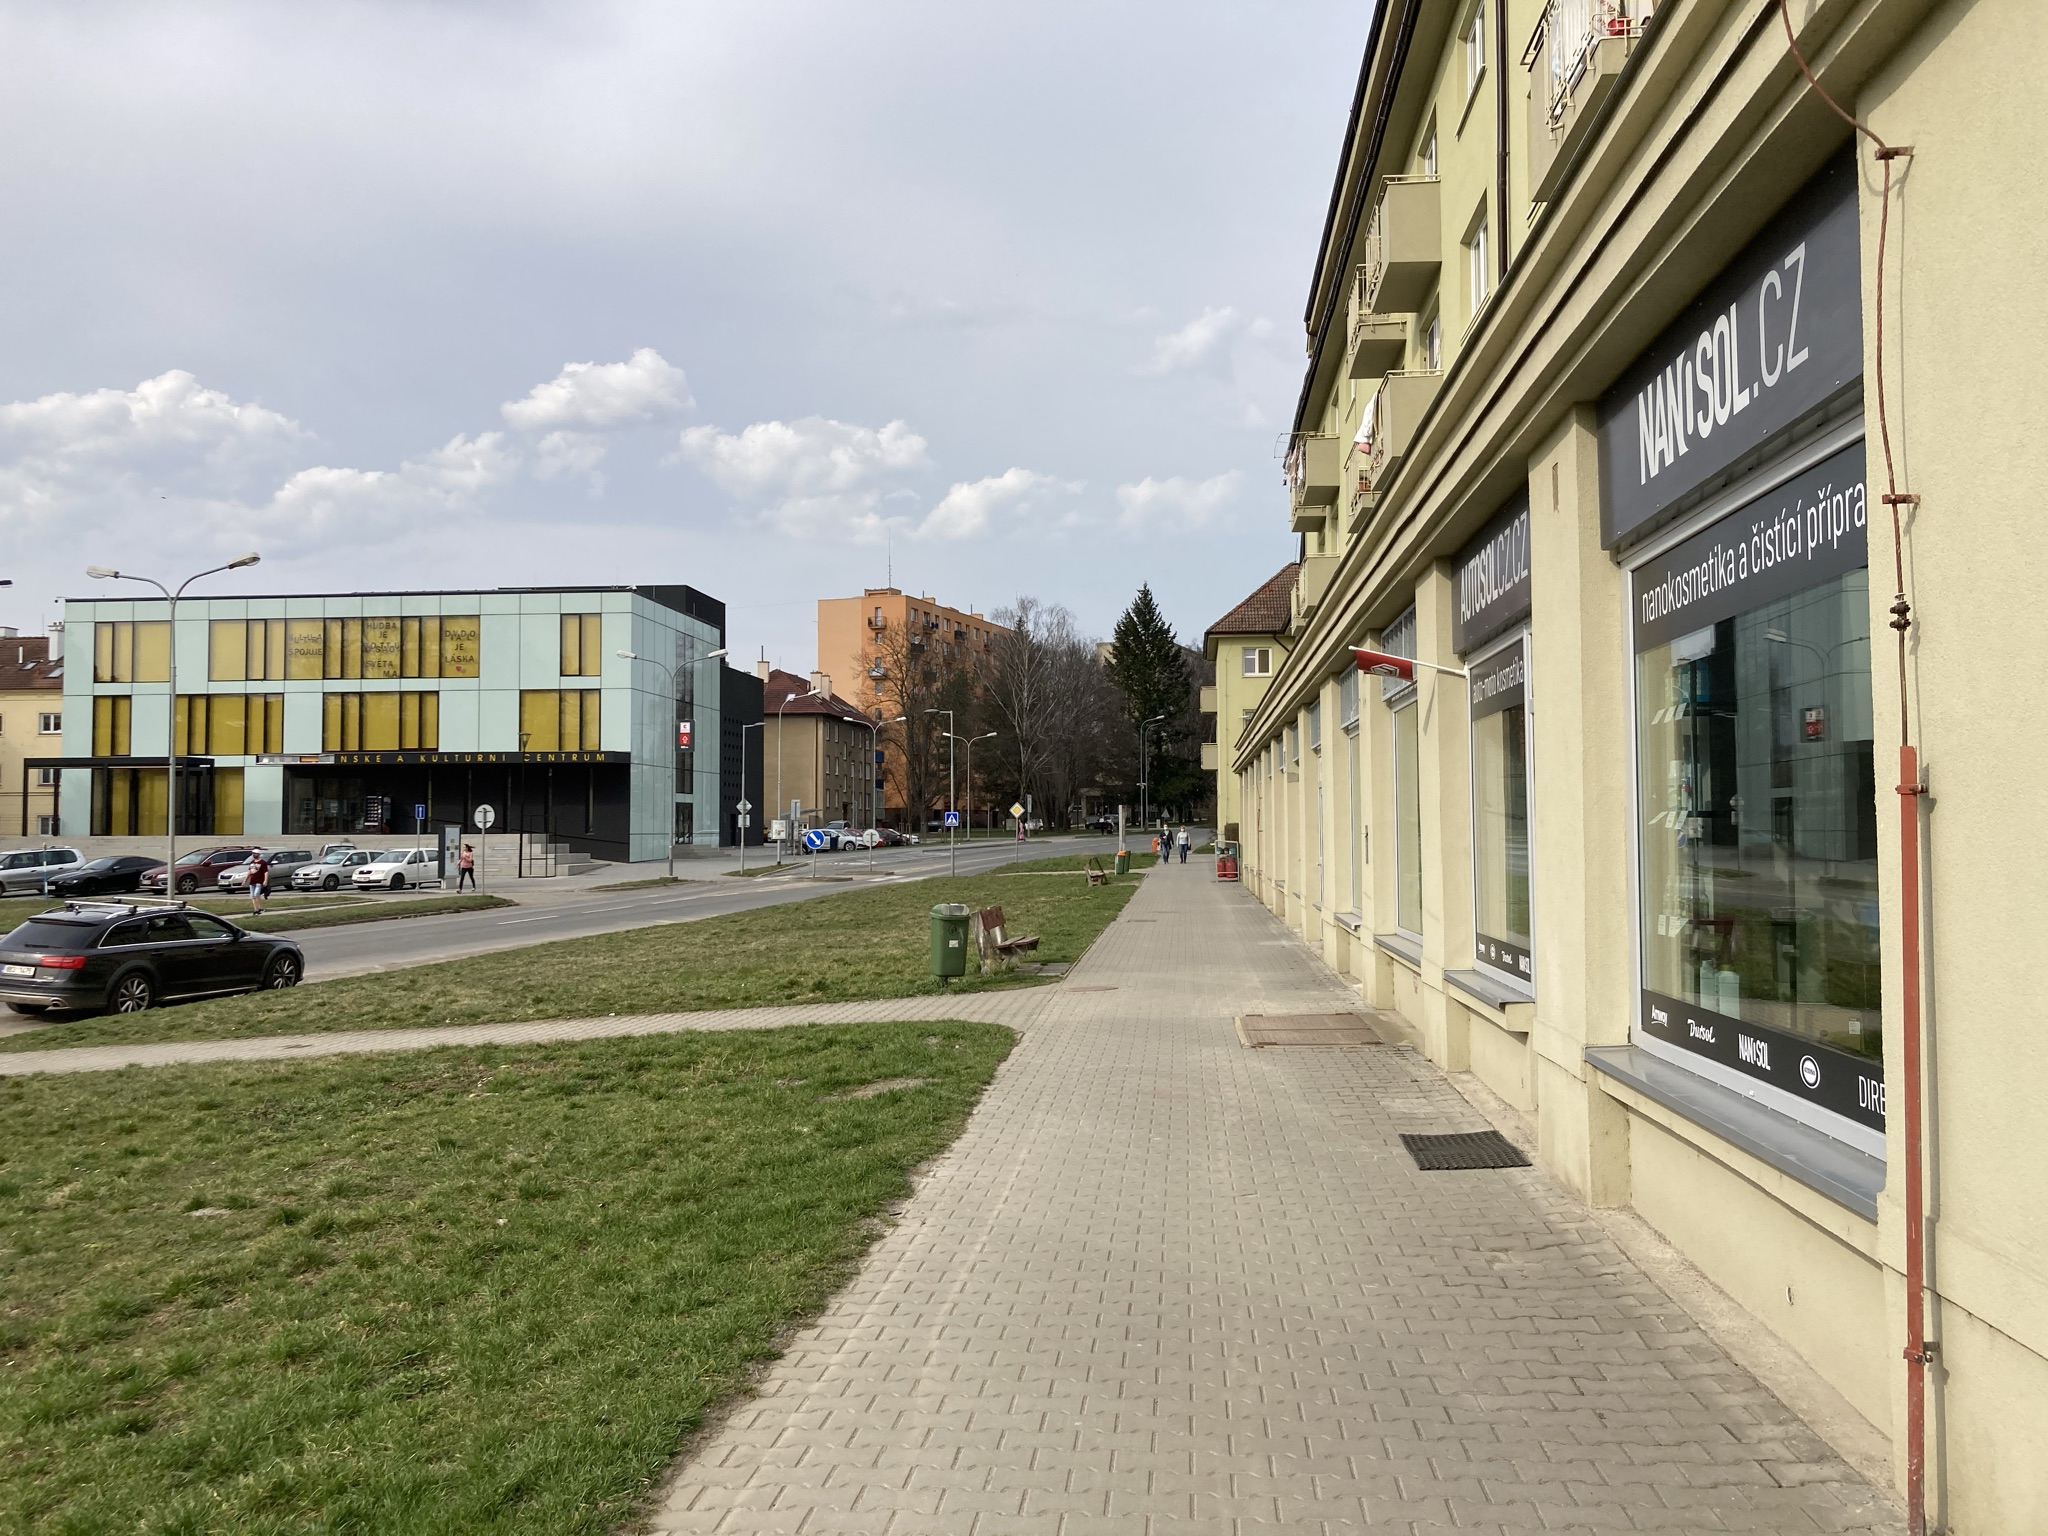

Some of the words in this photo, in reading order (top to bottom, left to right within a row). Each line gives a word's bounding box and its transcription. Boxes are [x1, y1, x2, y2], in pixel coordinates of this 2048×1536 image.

[1642, 543, 1735, 624] nanokosmetika
[1739, 542, 1748, 580] a
[1751, 499, 1801, 574] čistící
[1807, 483, 1866, 561] přípra
[366, 622, 397, 630] HUDBA
[378, 631, 388, 639] JE
[445, 630, 476, 641] DIVADLO
[454, 643, 465, 651] JE
[288, 648, 322, 656] SPOJUJE
[365, 657, 394, 668] SVĚTA
[396, 755, 404, 763] A
